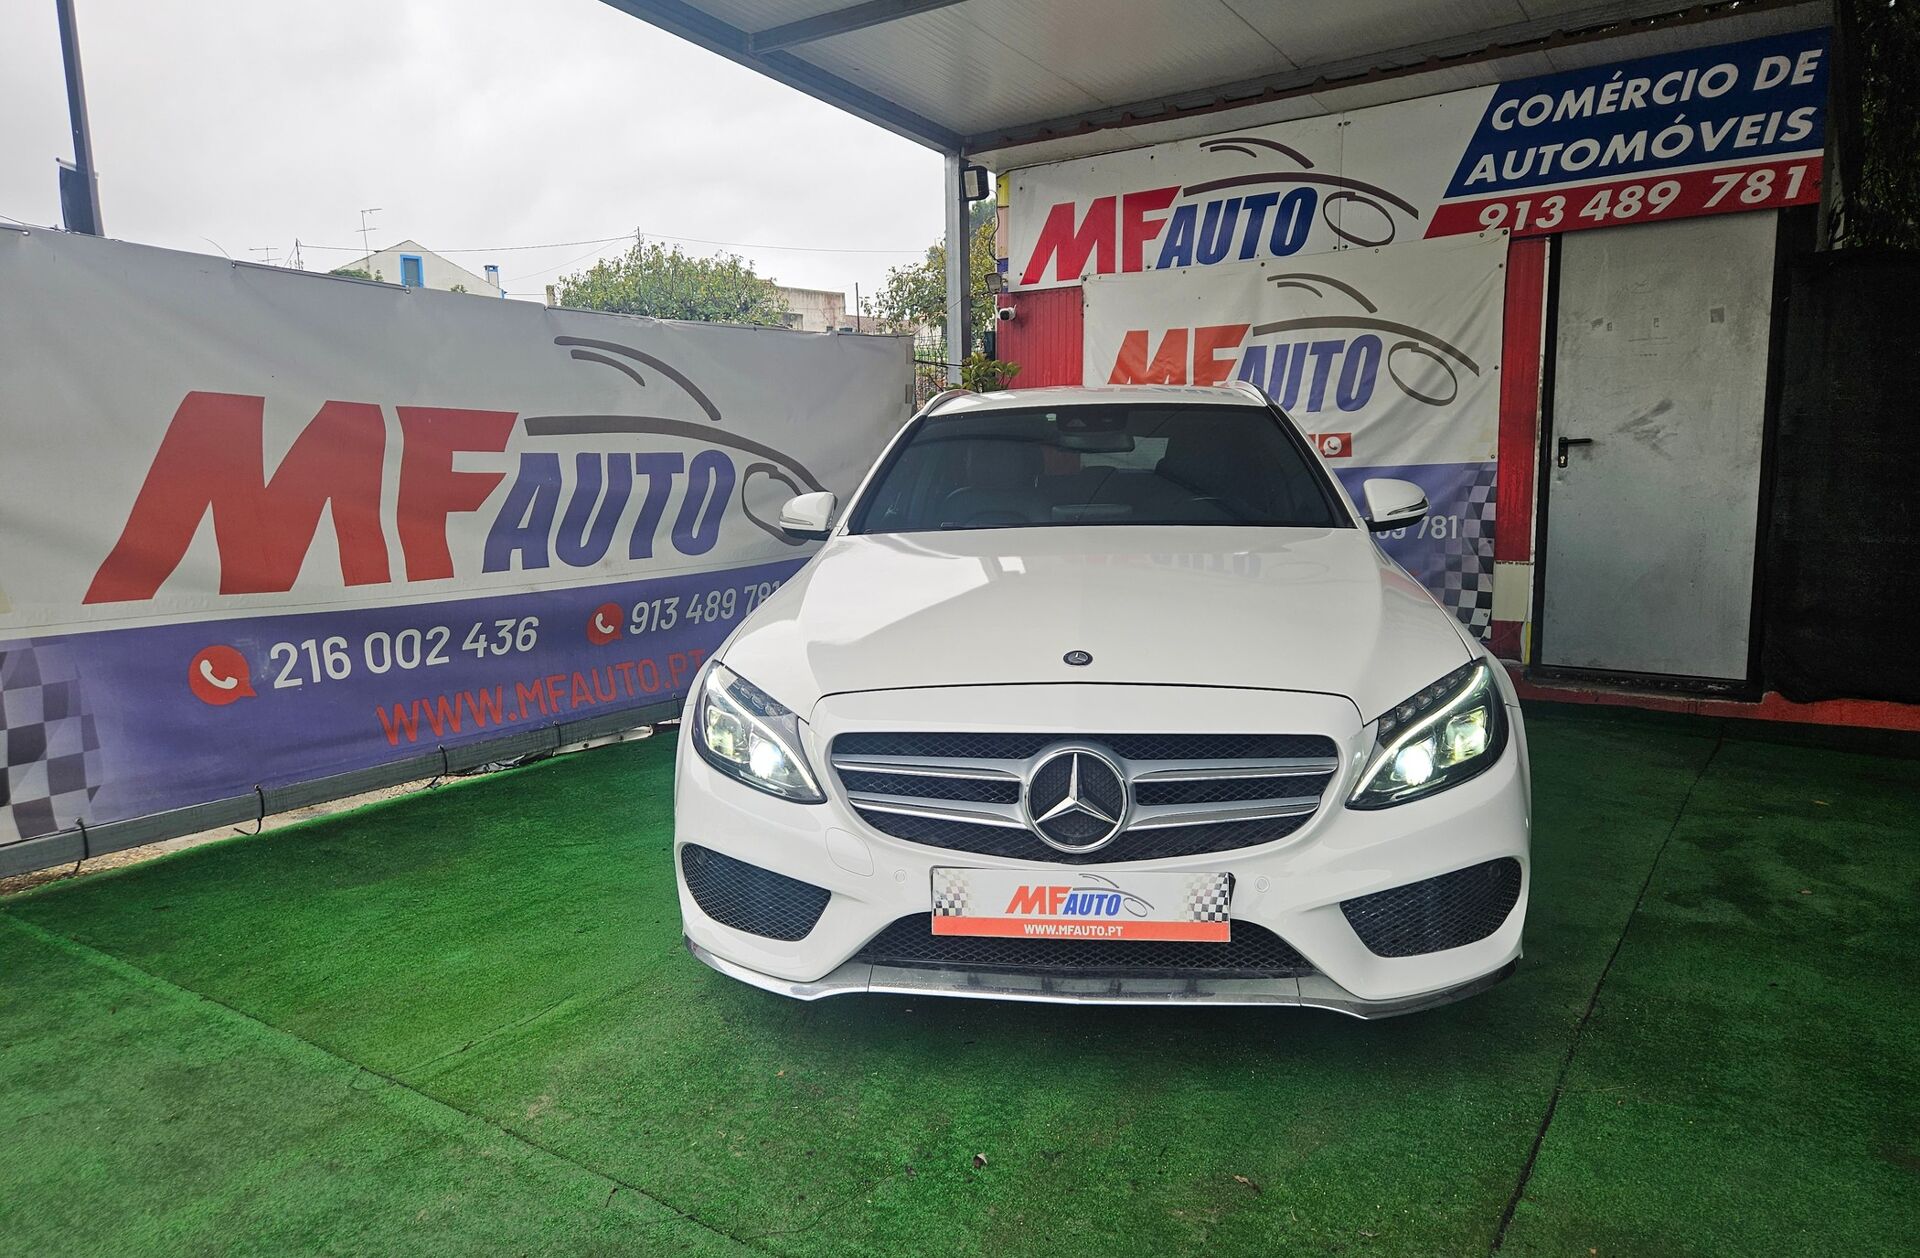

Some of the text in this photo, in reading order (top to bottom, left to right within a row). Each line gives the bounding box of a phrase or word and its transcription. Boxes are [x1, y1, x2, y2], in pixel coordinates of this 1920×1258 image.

[1491, 49, 1823, 132] COMÉRCIO DE
[1463, 106, 1818, 186] AUTOMÓVEIS
[1478, 165, 1808, 232] 913 489 781
[1417, 514, 1458, 539] 781
[629, 596, 680, 635] 913
[685, 588, 736, 625] 489
[270, 616, 540, 690] 216 002 436
[1024, 924, 1123, 936] WWW.MFAUTO.PT
